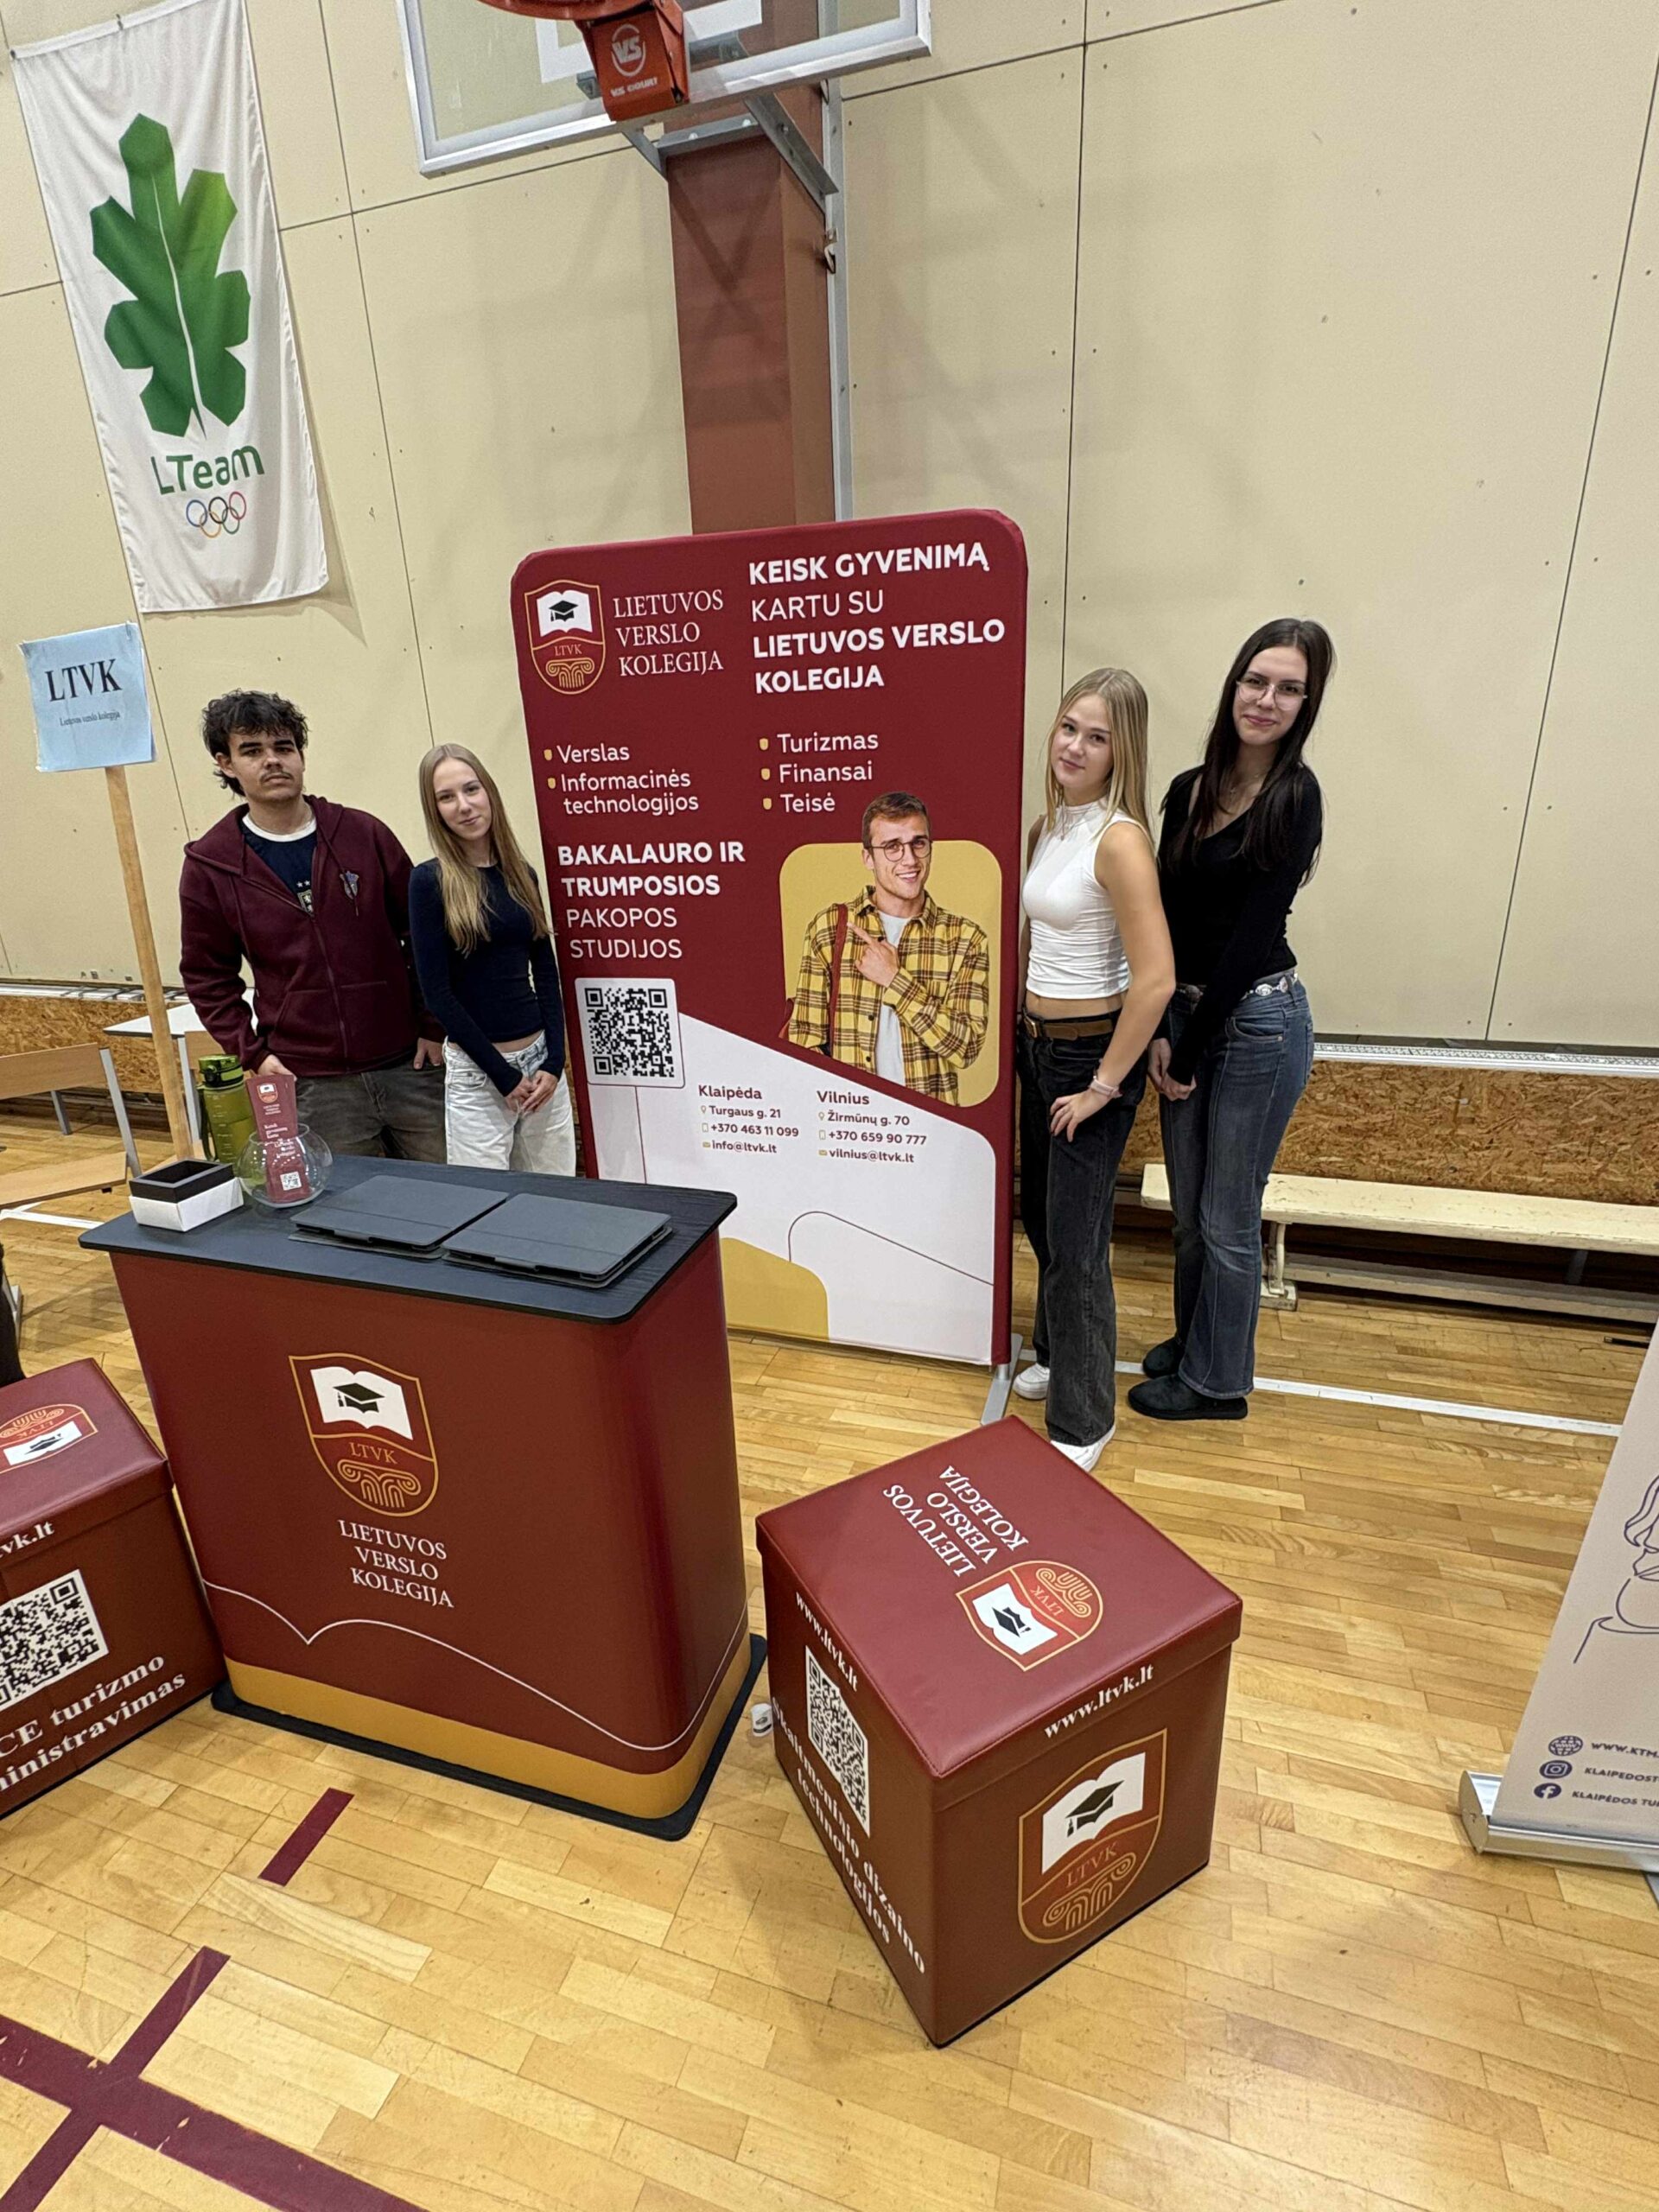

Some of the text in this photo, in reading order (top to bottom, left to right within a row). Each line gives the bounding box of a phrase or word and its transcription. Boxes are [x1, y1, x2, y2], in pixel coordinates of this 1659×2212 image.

[612, 35, 642, 64] VS
[150, 445, 265, 495] LTeam
[749, 542, 990, 585] KEISK GYVENIMĄ
[613, 588, 723, 619] LIETUVOS
[752, 589, 884, 623] KARTU SU
[616, 621, 700, 647] VERSLO
[753, 619, 1005, 658] LIETUVOS VERSLO
[555, 644, 582, 656] LTVK
[620, 652, 724, 677] KOLEGIJA
[44, 658, 123, 702] LTVK
[756, 664, 885, 694] KOLEGIJA
[557, 743, 630, 764] Verslas
[778, 732, 879, 753] Turizmas
[562, 769, 691, 792] Informacinės
[779, 760, 873, 784] Finansai
[563, 793, 699, 816] technologijos
[780, 791, 835, 813] Teisė
[557, 841, 745, 866] BAKALAURO IR
[562, 874, 721, 898] TRUMPOSIOS
[566, 906, 677, 929] PAKOPOS
[569, 938, 683, 960] STUDIJOS
[698, 1085, 762, 1101] Klaipėda
[817, 1090, 869, 1105] Vilnius
[709, 1106, 781, 1119] Turgaus g. 21
[828, 1109, 910, 1127] Žirmūnų g. 70
[711, 1123, 798, 1137] +370 463 11 099
[829, 1131, 926, 1145] +370 659 90 777
[713, 1141, 777, 1154] info@ltvk.lt
[829, 1149, 914, 1163] vilnius@ltvk.lt
[17, 1421, 54, 1439] LTVK
[349, 1442, 397, 1465] LTVK
[938, 1465, 1029, 1551] KOLEGIJA
[0, 1521, 55, 1557] vk.lt
[338, 1519, 447, 1560] LIETUVOS
[882, 1484, 976, 1578] LIETUVOS
[926, 1492, 998, 1564] VERSLO
[354, 1546, 438, 1580] VERSLO
[350, 1567, 454, 1608] KOLEGIJA
[1030, 1585, 1065, 1618] LTVK
[795, 1591, 858, 1692] www.ltvk.lt
[49, 1656, 164, 1726] turizmo
[1044, 1663, 1154, 1738] www.ltvk.lt
[1572, 1790, 1637, 1805] KLAIPĖDOS
[772, 1696, 925, 1974] Skaitmeninio dizaino
[797, 1768, 890, 1945] technologijos
[1065, 1841, 1118, 1888] LTVK
